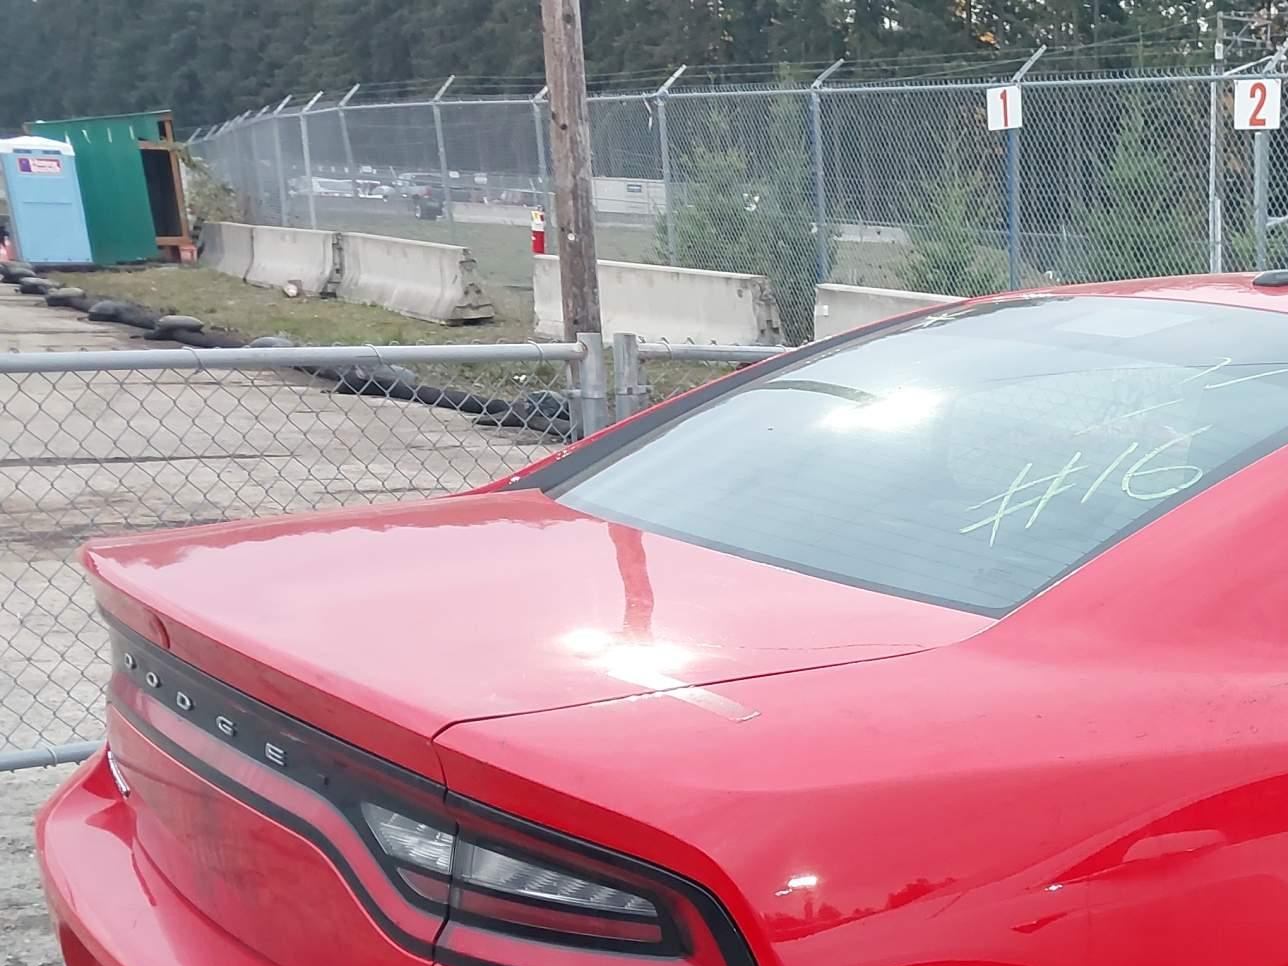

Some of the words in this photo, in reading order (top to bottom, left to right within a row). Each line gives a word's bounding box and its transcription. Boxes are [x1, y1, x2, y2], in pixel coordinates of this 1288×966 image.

[1000, 89, 1009, 128] 1
[1249, 82, 1267, 126] 2
[960, 424, 1213, 548] #16
[124, 652, 287, 767] DODGE
